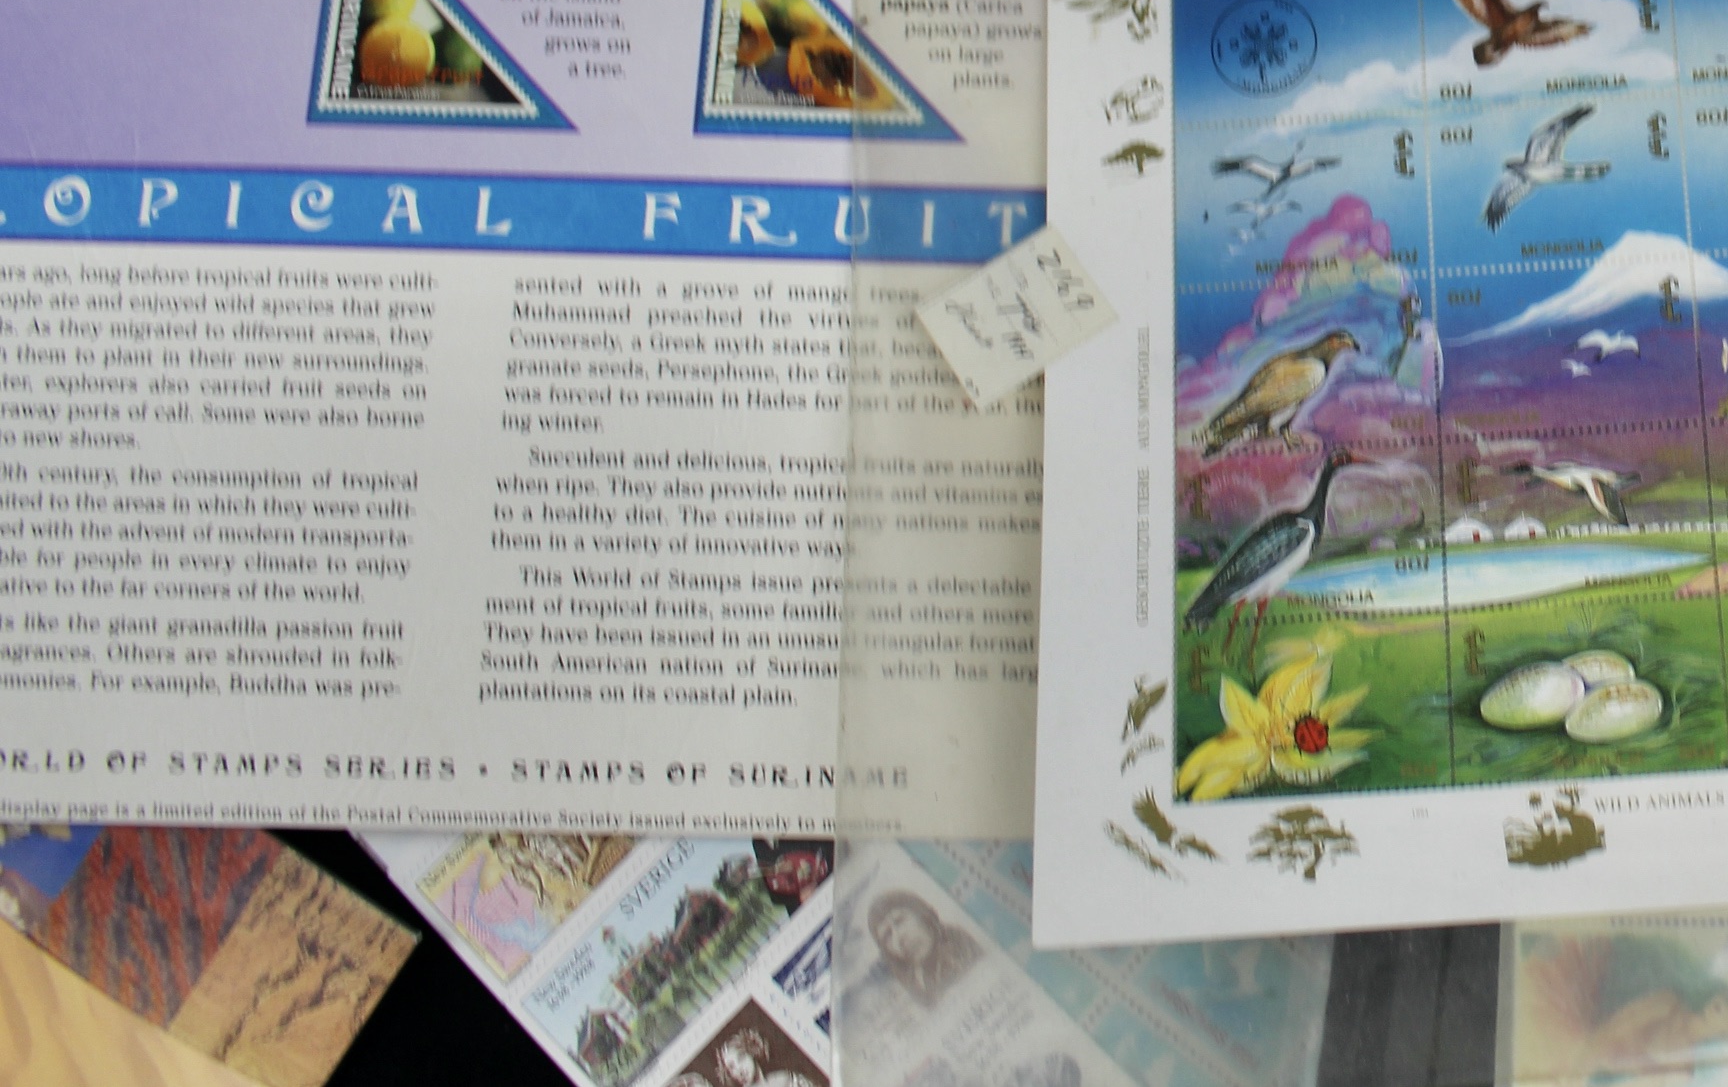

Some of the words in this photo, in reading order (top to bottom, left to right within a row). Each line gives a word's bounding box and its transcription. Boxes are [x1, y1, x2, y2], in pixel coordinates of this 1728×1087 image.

[1545, 72, 1629, 94] MONGOLIA
[0, 172, 513, 238] OPICAL
[642, 191, 1028, 249] FRUIT
[1520, 237, 1606, 259] MONGOLIA
[48, 291, 79, 309] ate
[85, 290, 123, 309] and
[128, 291, 207, 316] enjoyed
[214, 294, 255, 312] wild
[261, 296, 334, 320] species
[341, 295, 380, 315] that
[387, 301, 435, 321] grew
[512, 302, 631, 322] Muhammad
[646, 305, 742, 331] preached
[759, 307, 791, 326] the
[505, 358, 581, 380] granate
[787, 362, 819, 381] the
[129, 463, 162, 484] the
[311, 469, 331, 488] of
[341, 469, 418, 495] tropical
[496, 474, 549, 492] when
[610, 475, 656, 498] They
[662, 476, 704, 497] also
[709, 478, 786, 503] provide
[35, 548, 62, 567] for
[73, 547, 142, 574] people
[150, 551, 169, 569] in
[178, 554, 235, 572] every
[243, 550, 317, 572] climate
[326, 555, 347, 572] to
[355, 557, 410, 578] enjoy
[522, 566, 562, 585] This
[572, 567, 631, 587] World
[640, 570, 659, 587] of
[668, 571, 741, 594] Stamps
[750, 572, 803, 590] issue
[1286, 588, 1376, 607] MONGOLIA
[90, 669, 122, 690] For
[229, 672, 307, 694] Buddha
[314, 680, 353, 695] was
[599, 686, 624, 700] on
[631, 684, 656, 701] its
[663, 682, 735, 703] coastal
[106, 750, 148, 776] OF
[168, 751, 304, 779] STAMPS
[325, 753, 458, 781] SERIES
[511, 759, 646, 785] STAMPS
[666, 761, 706, 785] OF
[728, 762, 910, 789] SURINAME
[1593, 794, 1641, 814] WILD
[1646, 789, 1726, 811] ANIMALS
[618, 835, 697, 922] SVERIGE
